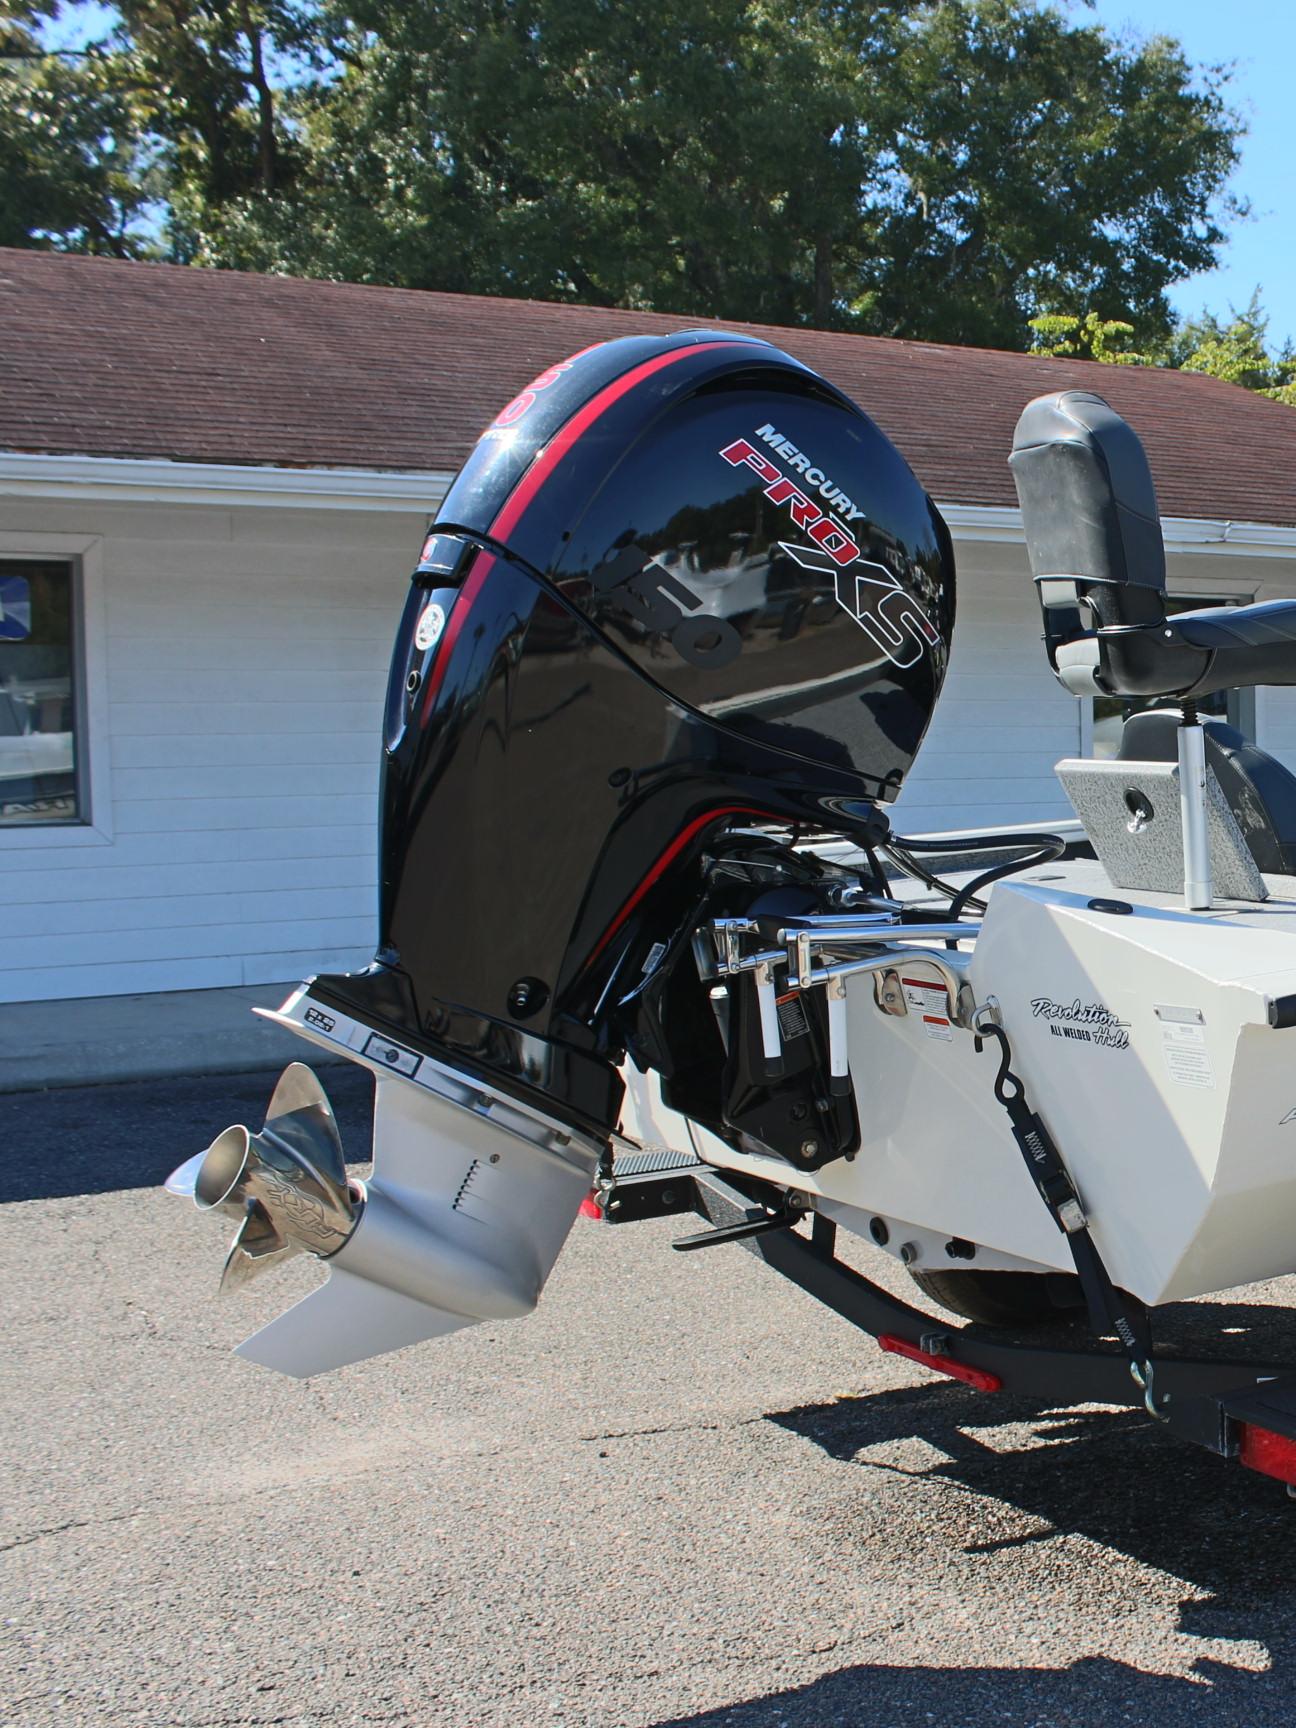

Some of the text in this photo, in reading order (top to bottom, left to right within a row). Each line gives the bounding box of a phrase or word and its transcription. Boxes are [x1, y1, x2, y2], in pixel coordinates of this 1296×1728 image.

[755, 424, 866, 521] MERCURY
[718, 438, 941, 668] PRO XS
[1031, 998, 1131, 1027] Revolution
[1051, 1025, 1129, 1050] ALL WELDED Hull
